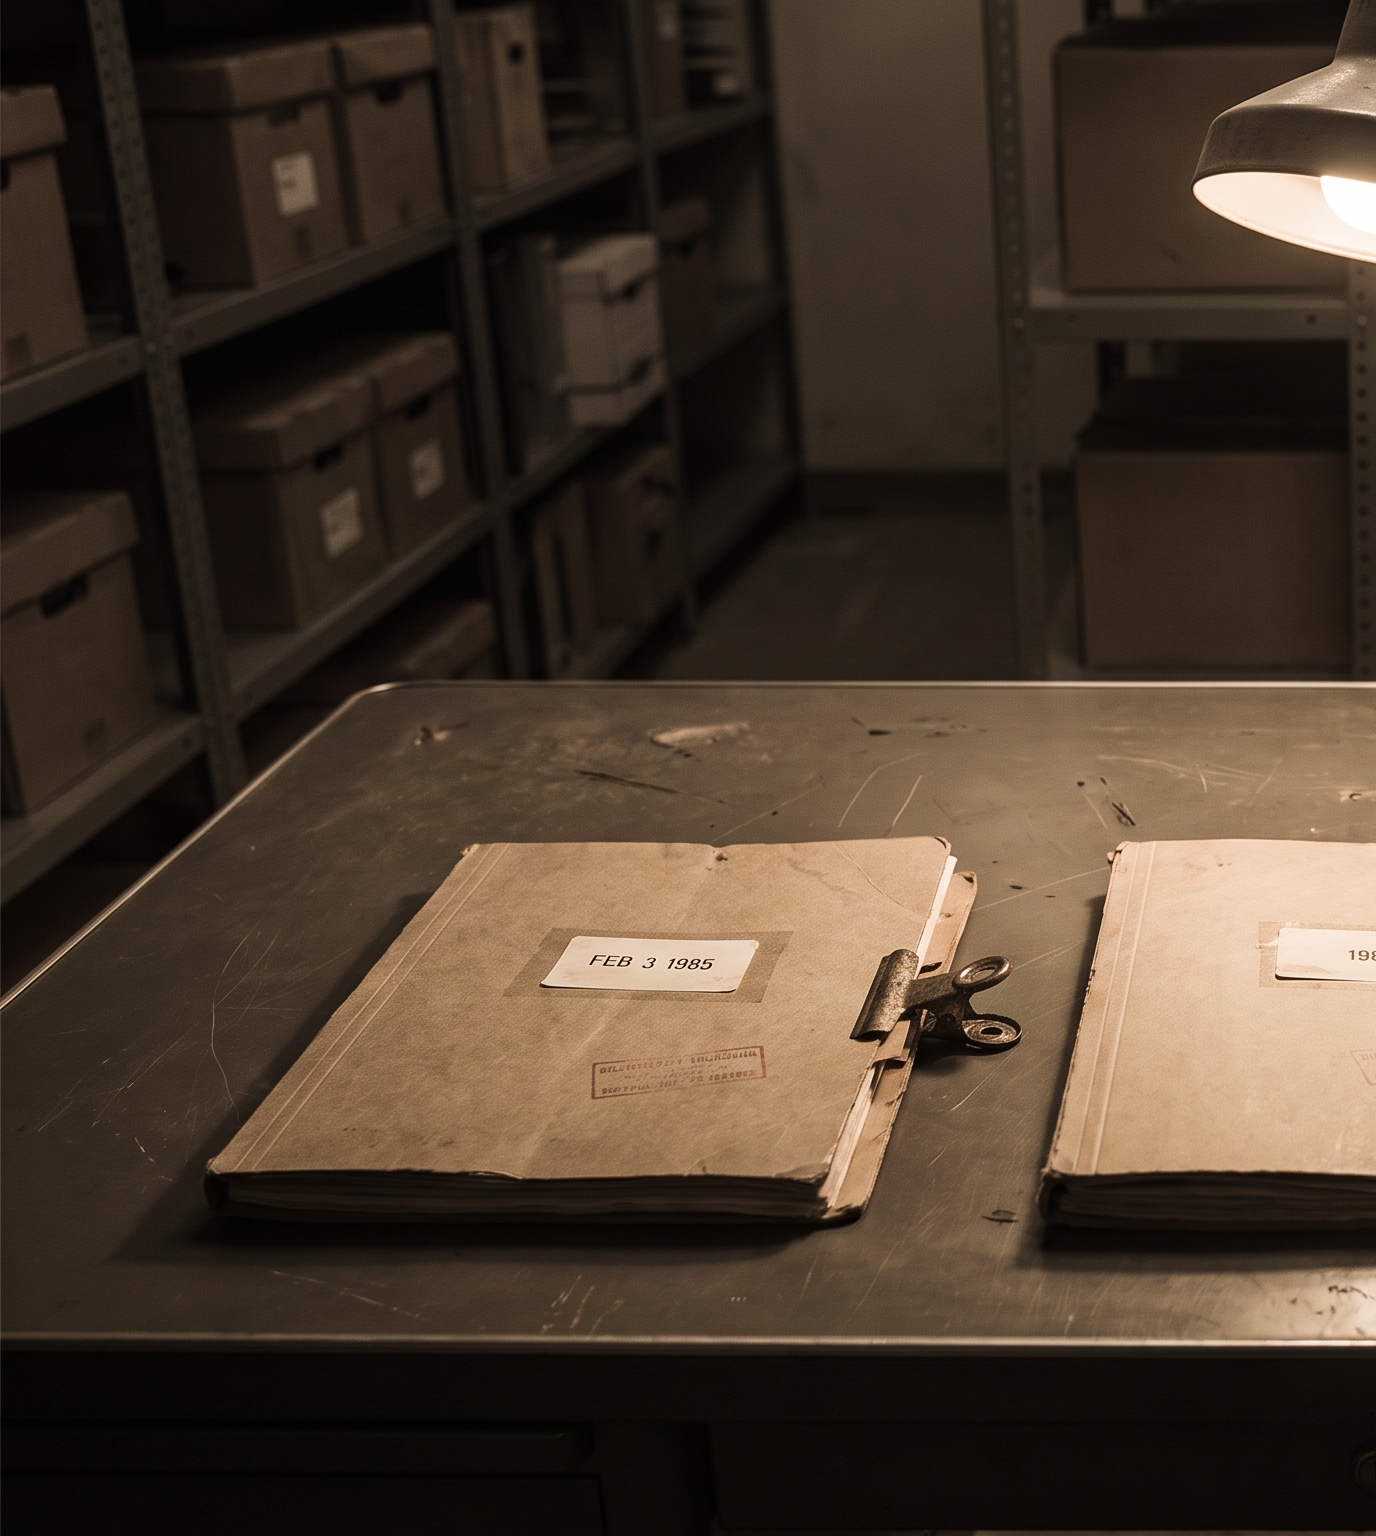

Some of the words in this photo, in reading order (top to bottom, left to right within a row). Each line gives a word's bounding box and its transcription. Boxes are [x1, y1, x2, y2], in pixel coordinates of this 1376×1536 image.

[588, 954, 633, 968] FEB
[641, 957, 657, 969] 3
[666, 958, 715, 970] 1985
